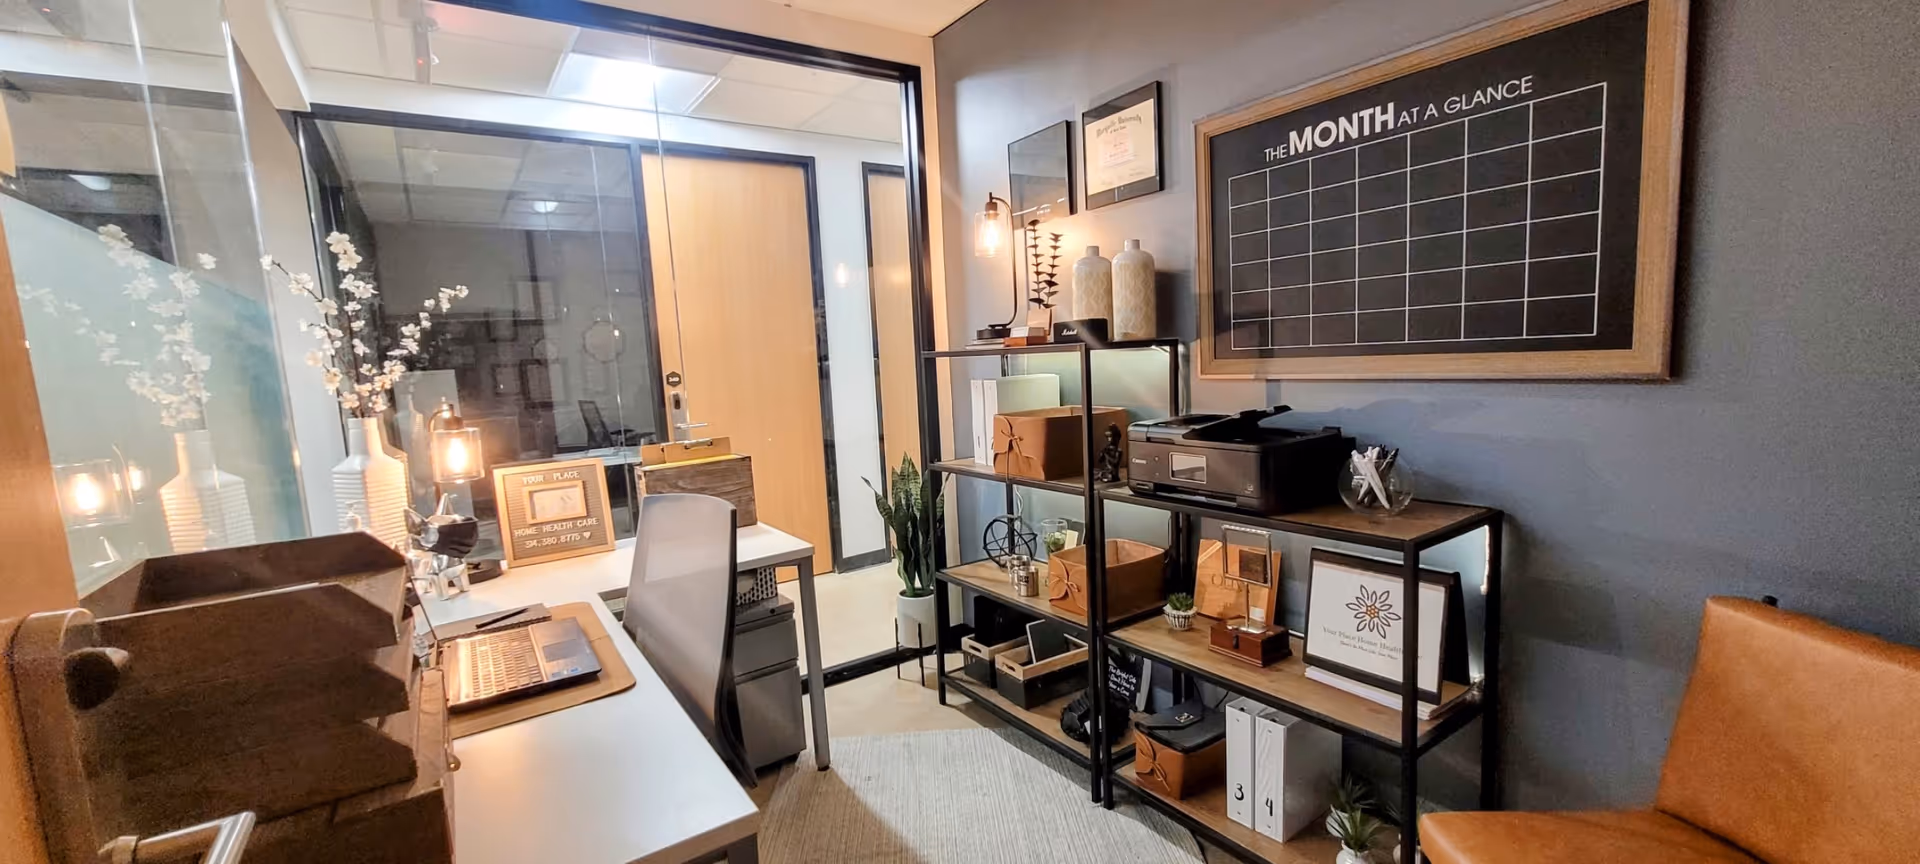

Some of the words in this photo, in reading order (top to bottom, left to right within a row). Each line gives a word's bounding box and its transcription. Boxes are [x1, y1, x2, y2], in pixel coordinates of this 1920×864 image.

[1264, 144, 1288, 162] THE
[1288, 101, 1395, 156] MONTH
[1397, 107, 1420, 128] AT
[1424, 103, 1439, 121] A
[1444, 75, 1534, 114] GLANCE
[522, 474, 545, 485] YOUR
[553, 470, 580, 481] PLACE
[513, 526, 539, 537] HOME
[542, 521, 573, 533] HEALTH
[577, 517, 600, 528] CARE
[1322, 625, 1337, 636] Your
[1338, 631, 1356, 641] Place
[1357, 636, 1378, 647] Home
[1234, 783, 1244, 801] 3
[1265, 797, 1273, 817] 4
